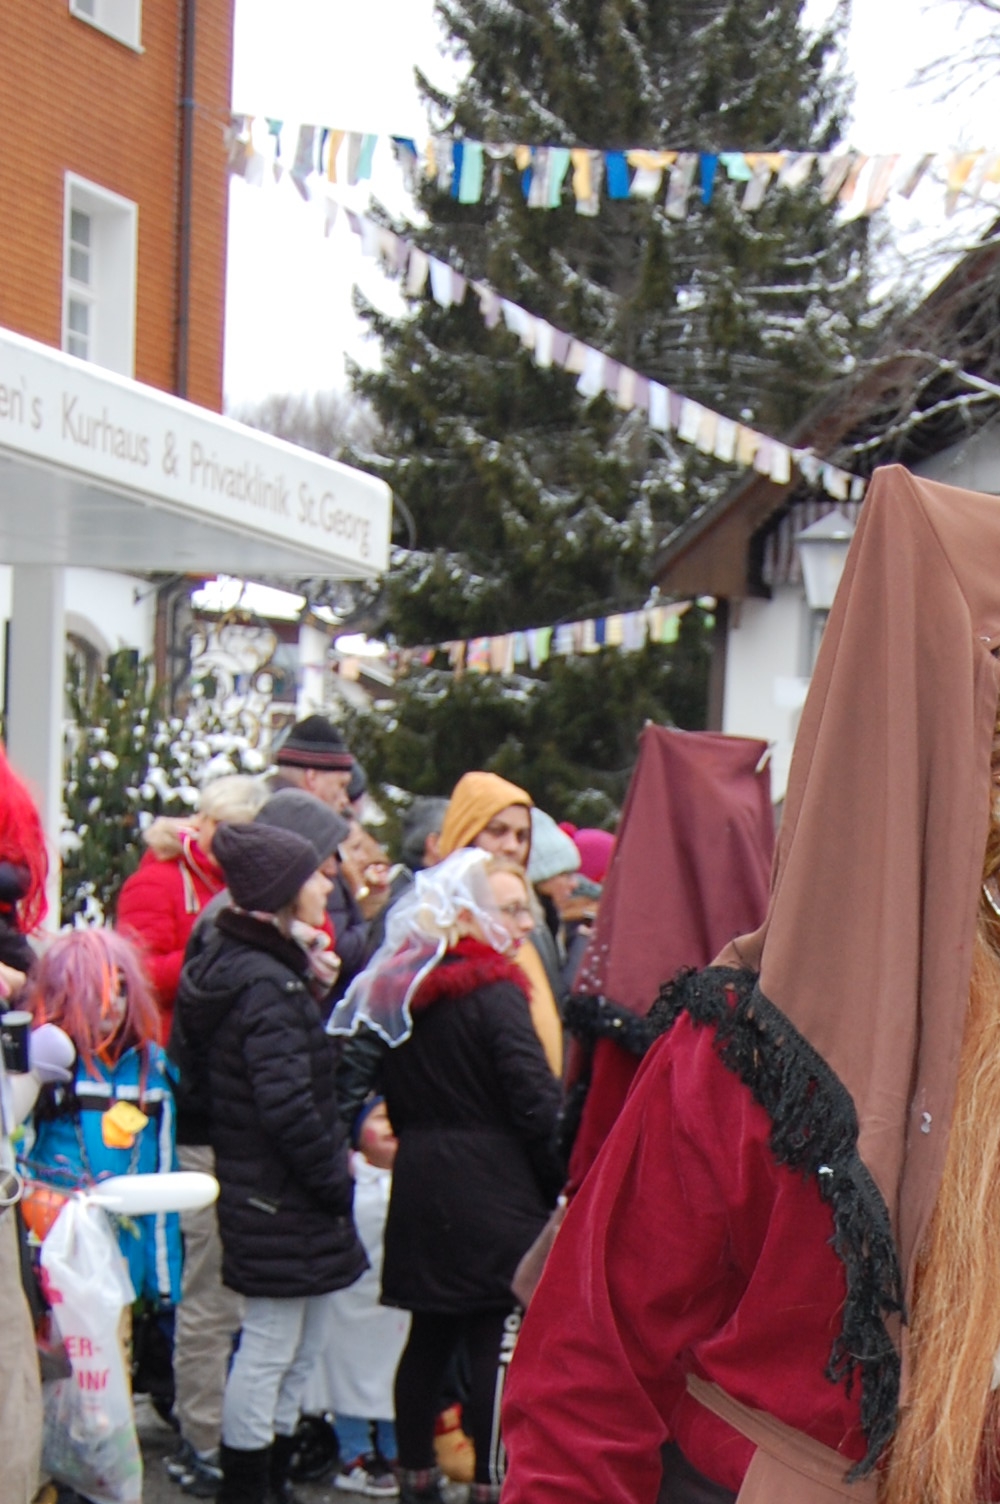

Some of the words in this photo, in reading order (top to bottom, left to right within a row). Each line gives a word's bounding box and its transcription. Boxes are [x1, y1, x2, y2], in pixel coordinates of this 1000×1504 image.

[61, 391, 150, 467] Kurhaus
[161, 431, 179, 479] &
[189, 440, 291, 517] Privatklinik
